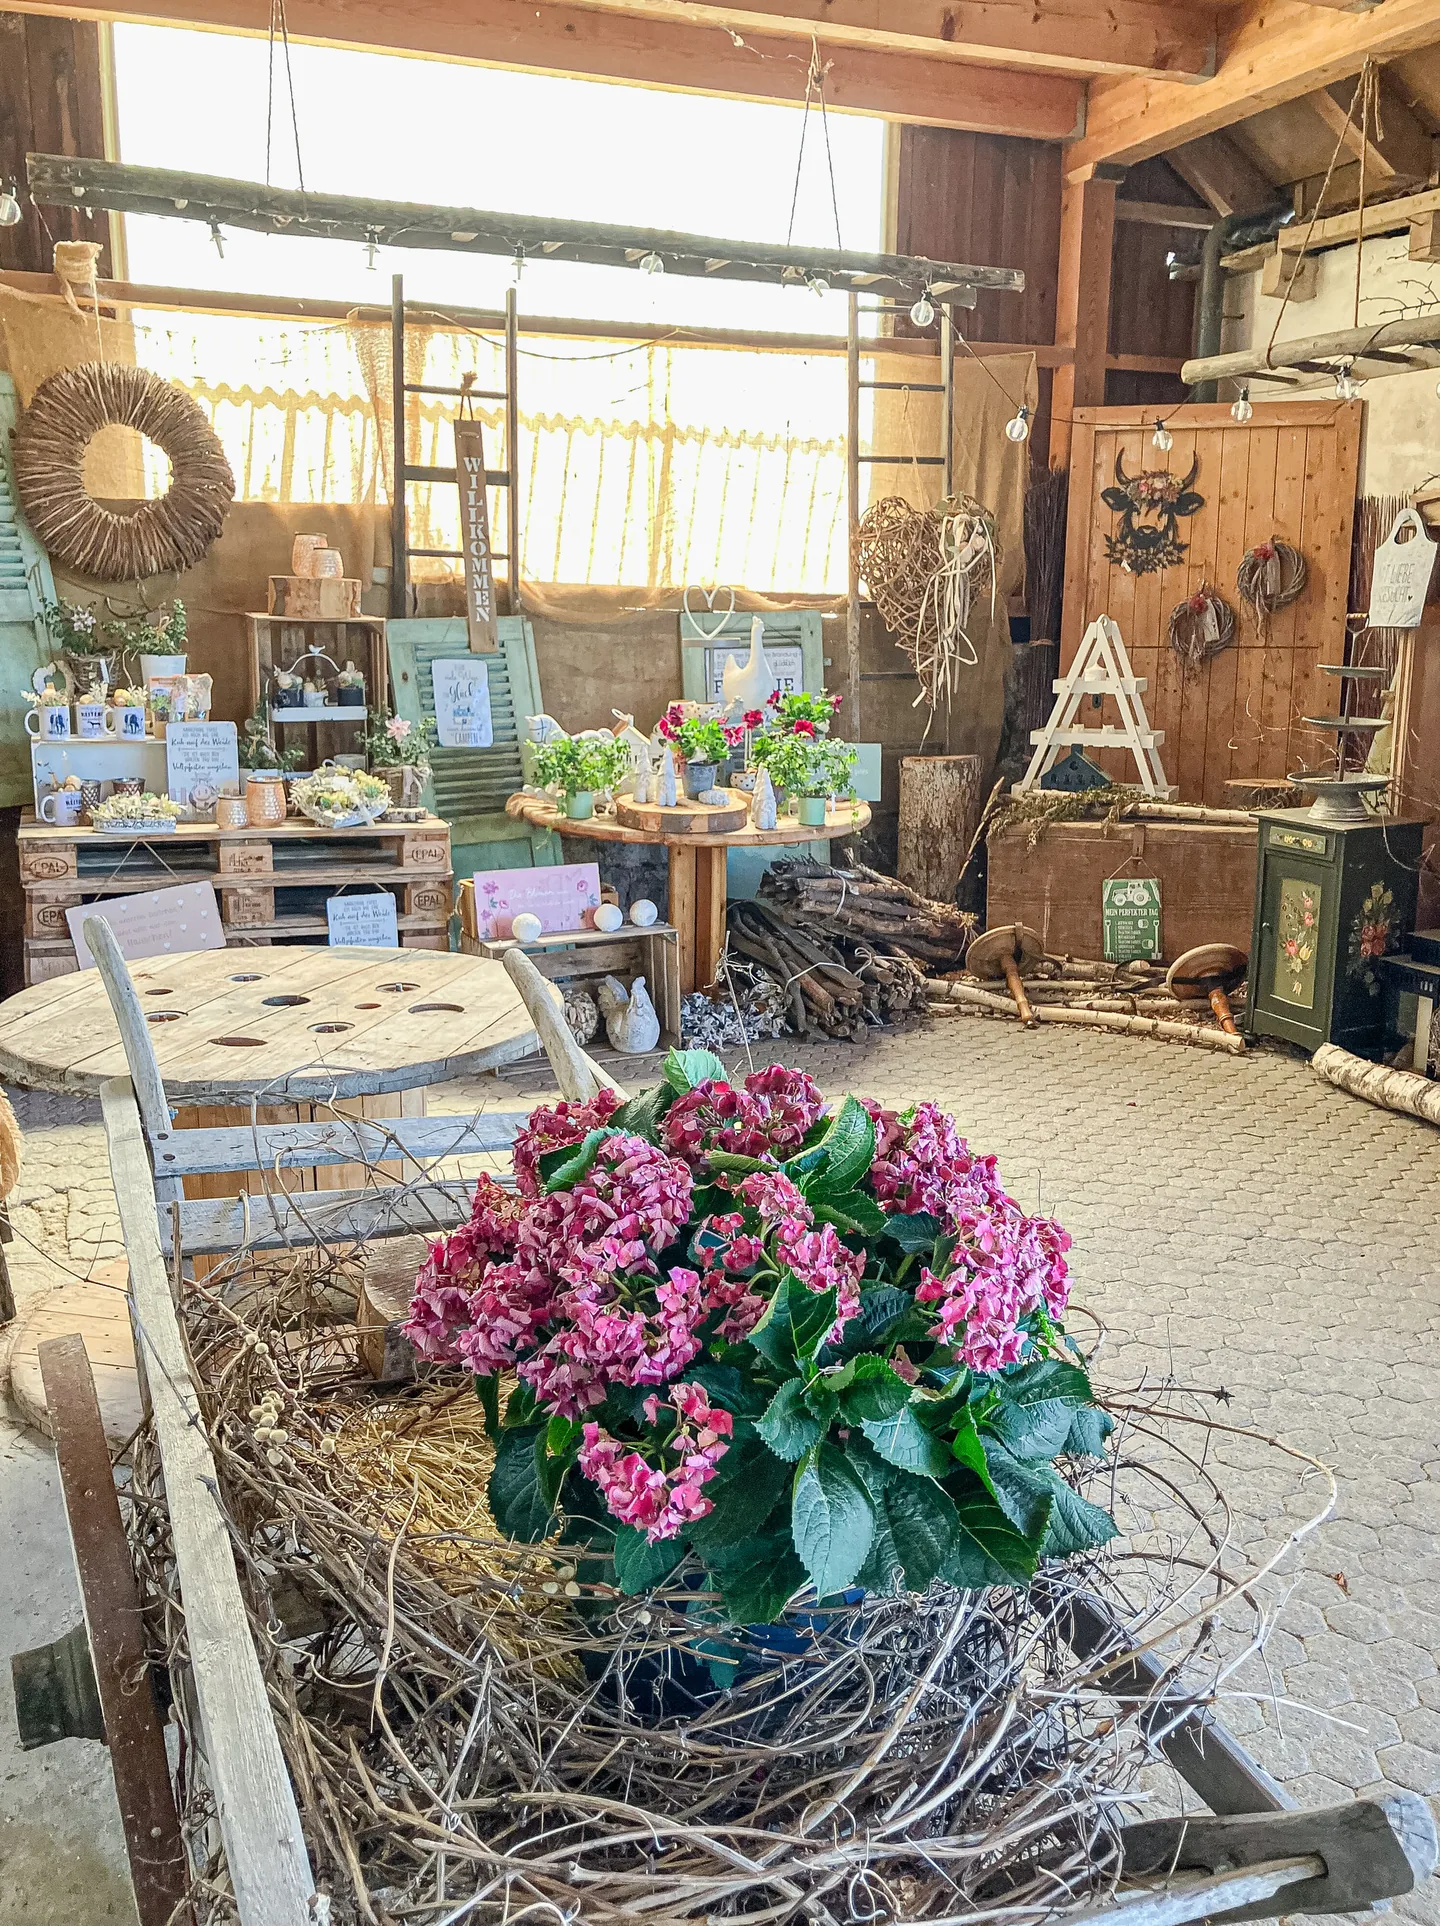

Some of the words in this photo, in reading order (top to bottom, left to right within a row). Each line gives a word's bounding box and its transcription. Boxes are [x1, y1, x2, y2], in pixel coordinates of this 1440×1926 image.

[463, 456, 492, 623] WILLKOMMEN
[417, 895, 442, 907] EPAL
[1105, 908, 1118, 916] MEIN
[1118, 908, 1148, 916] PERFEKTER
[1148, 908, 1159, 916] TAG
